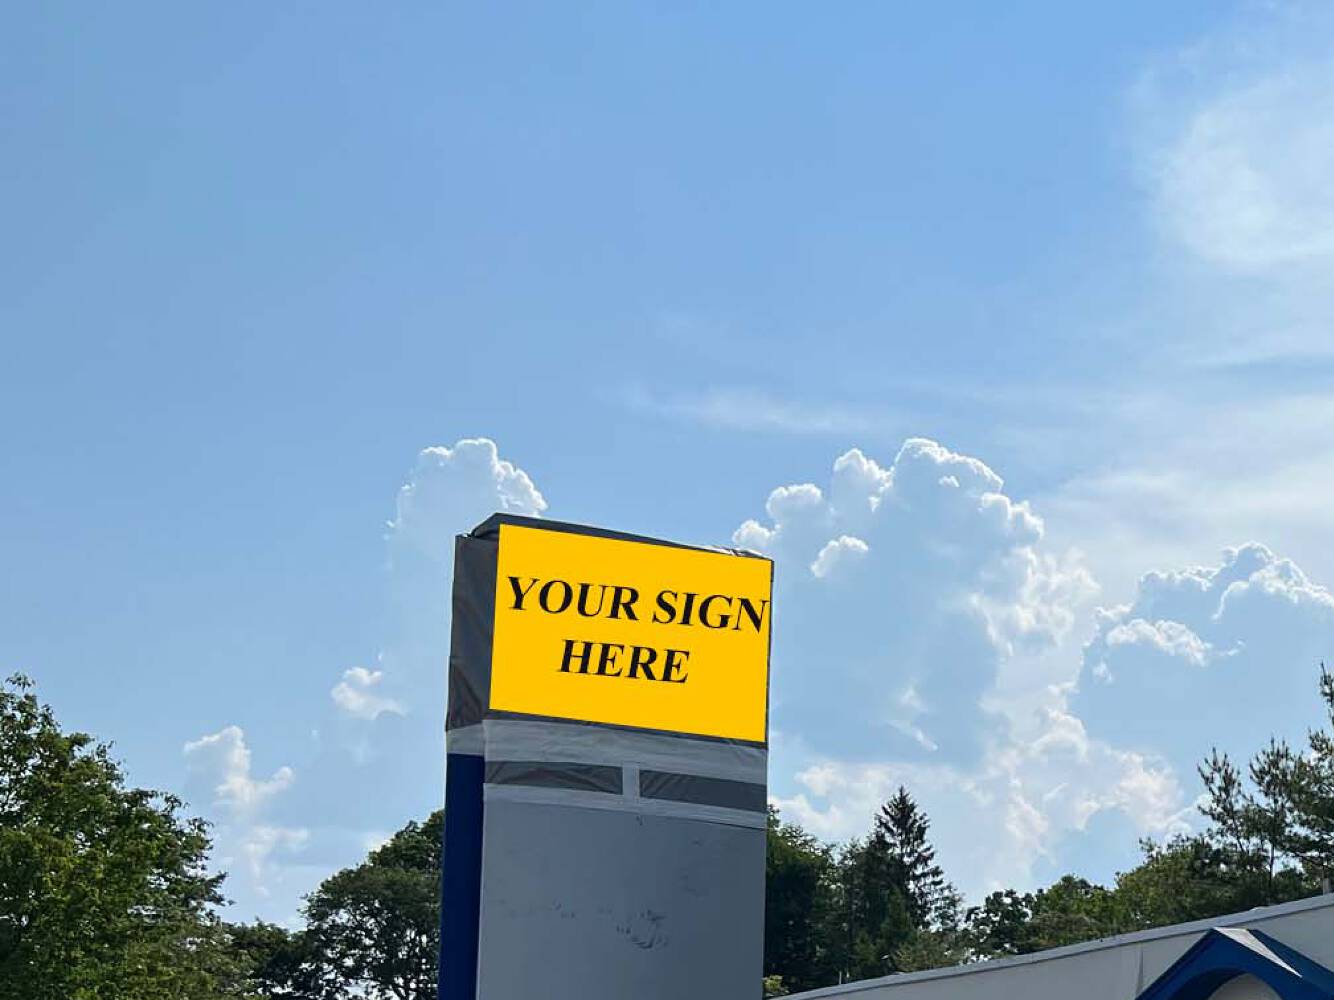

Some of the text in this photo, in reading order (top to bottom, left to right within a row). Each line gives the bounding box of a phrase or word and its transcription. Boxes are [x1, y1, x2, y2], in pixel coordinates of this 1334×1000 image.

[507, 576, 770, 633] YOUR SIGN
[555, 639, 690, 684] HERE
